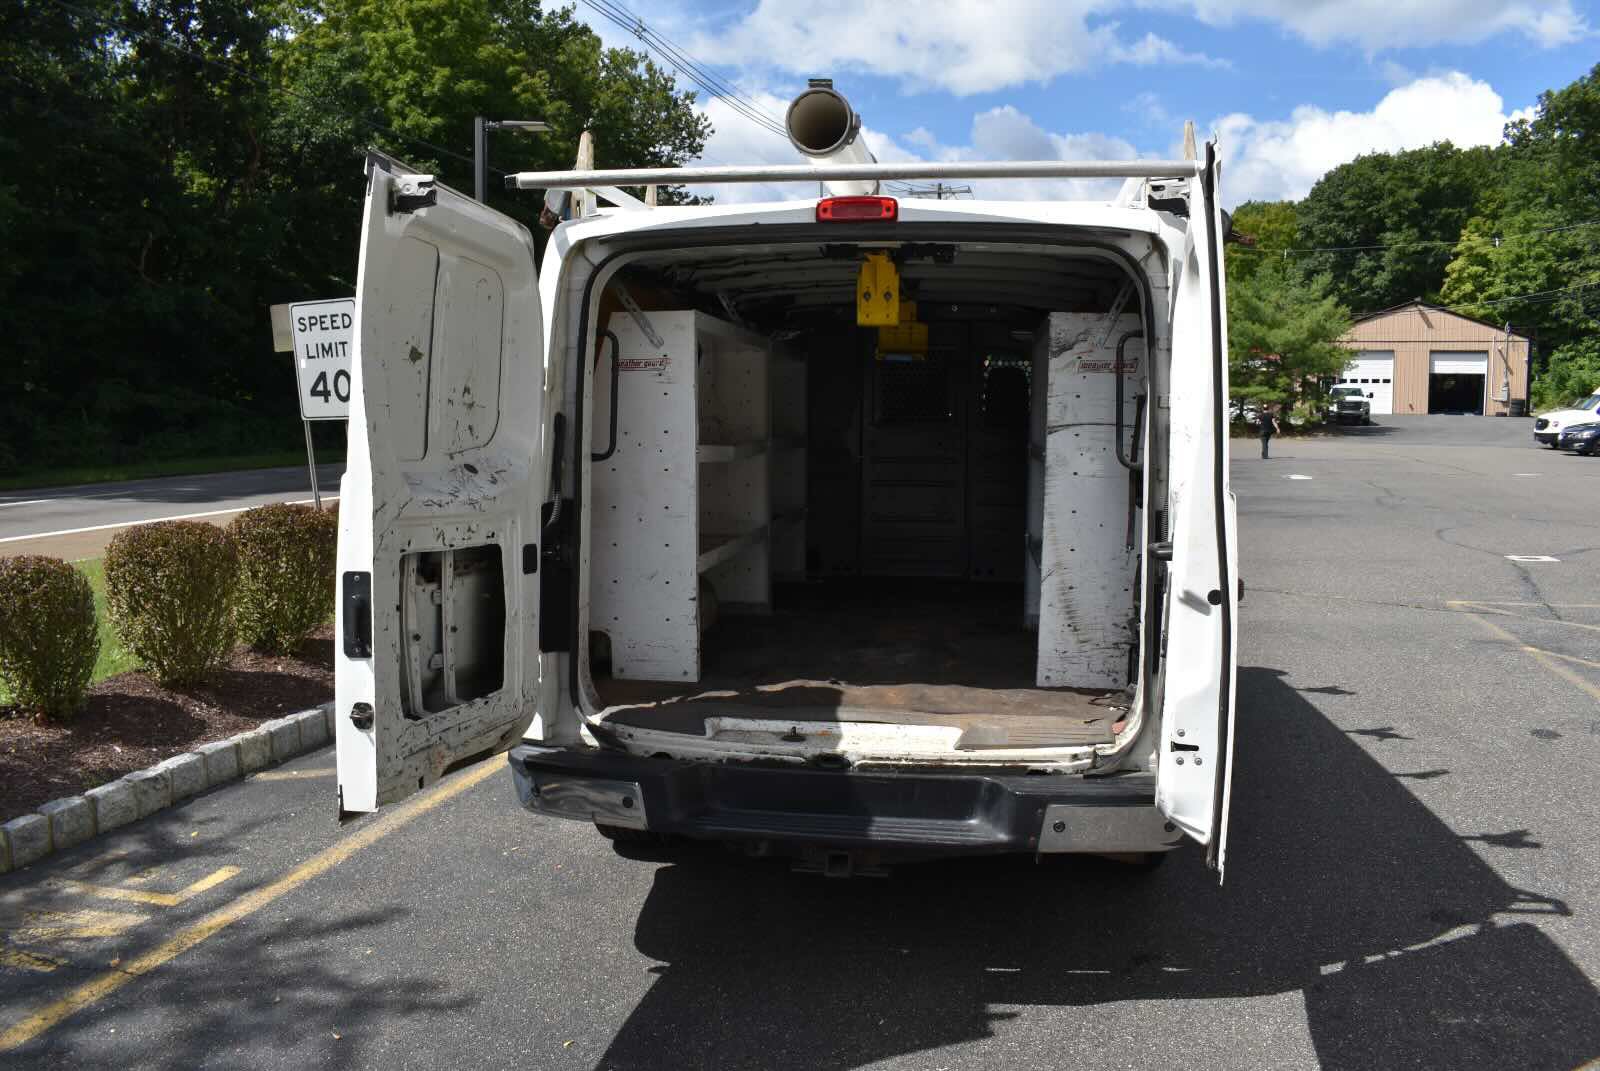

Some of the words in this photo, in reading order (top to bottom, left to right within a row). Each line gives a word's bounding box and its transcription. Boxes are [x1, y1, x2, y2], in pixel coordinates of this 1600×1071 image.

[298, 313, 352, 332] SPEED
[305, 341, 348, 359] LIMIT
[310, 369, 351, 403] 40
